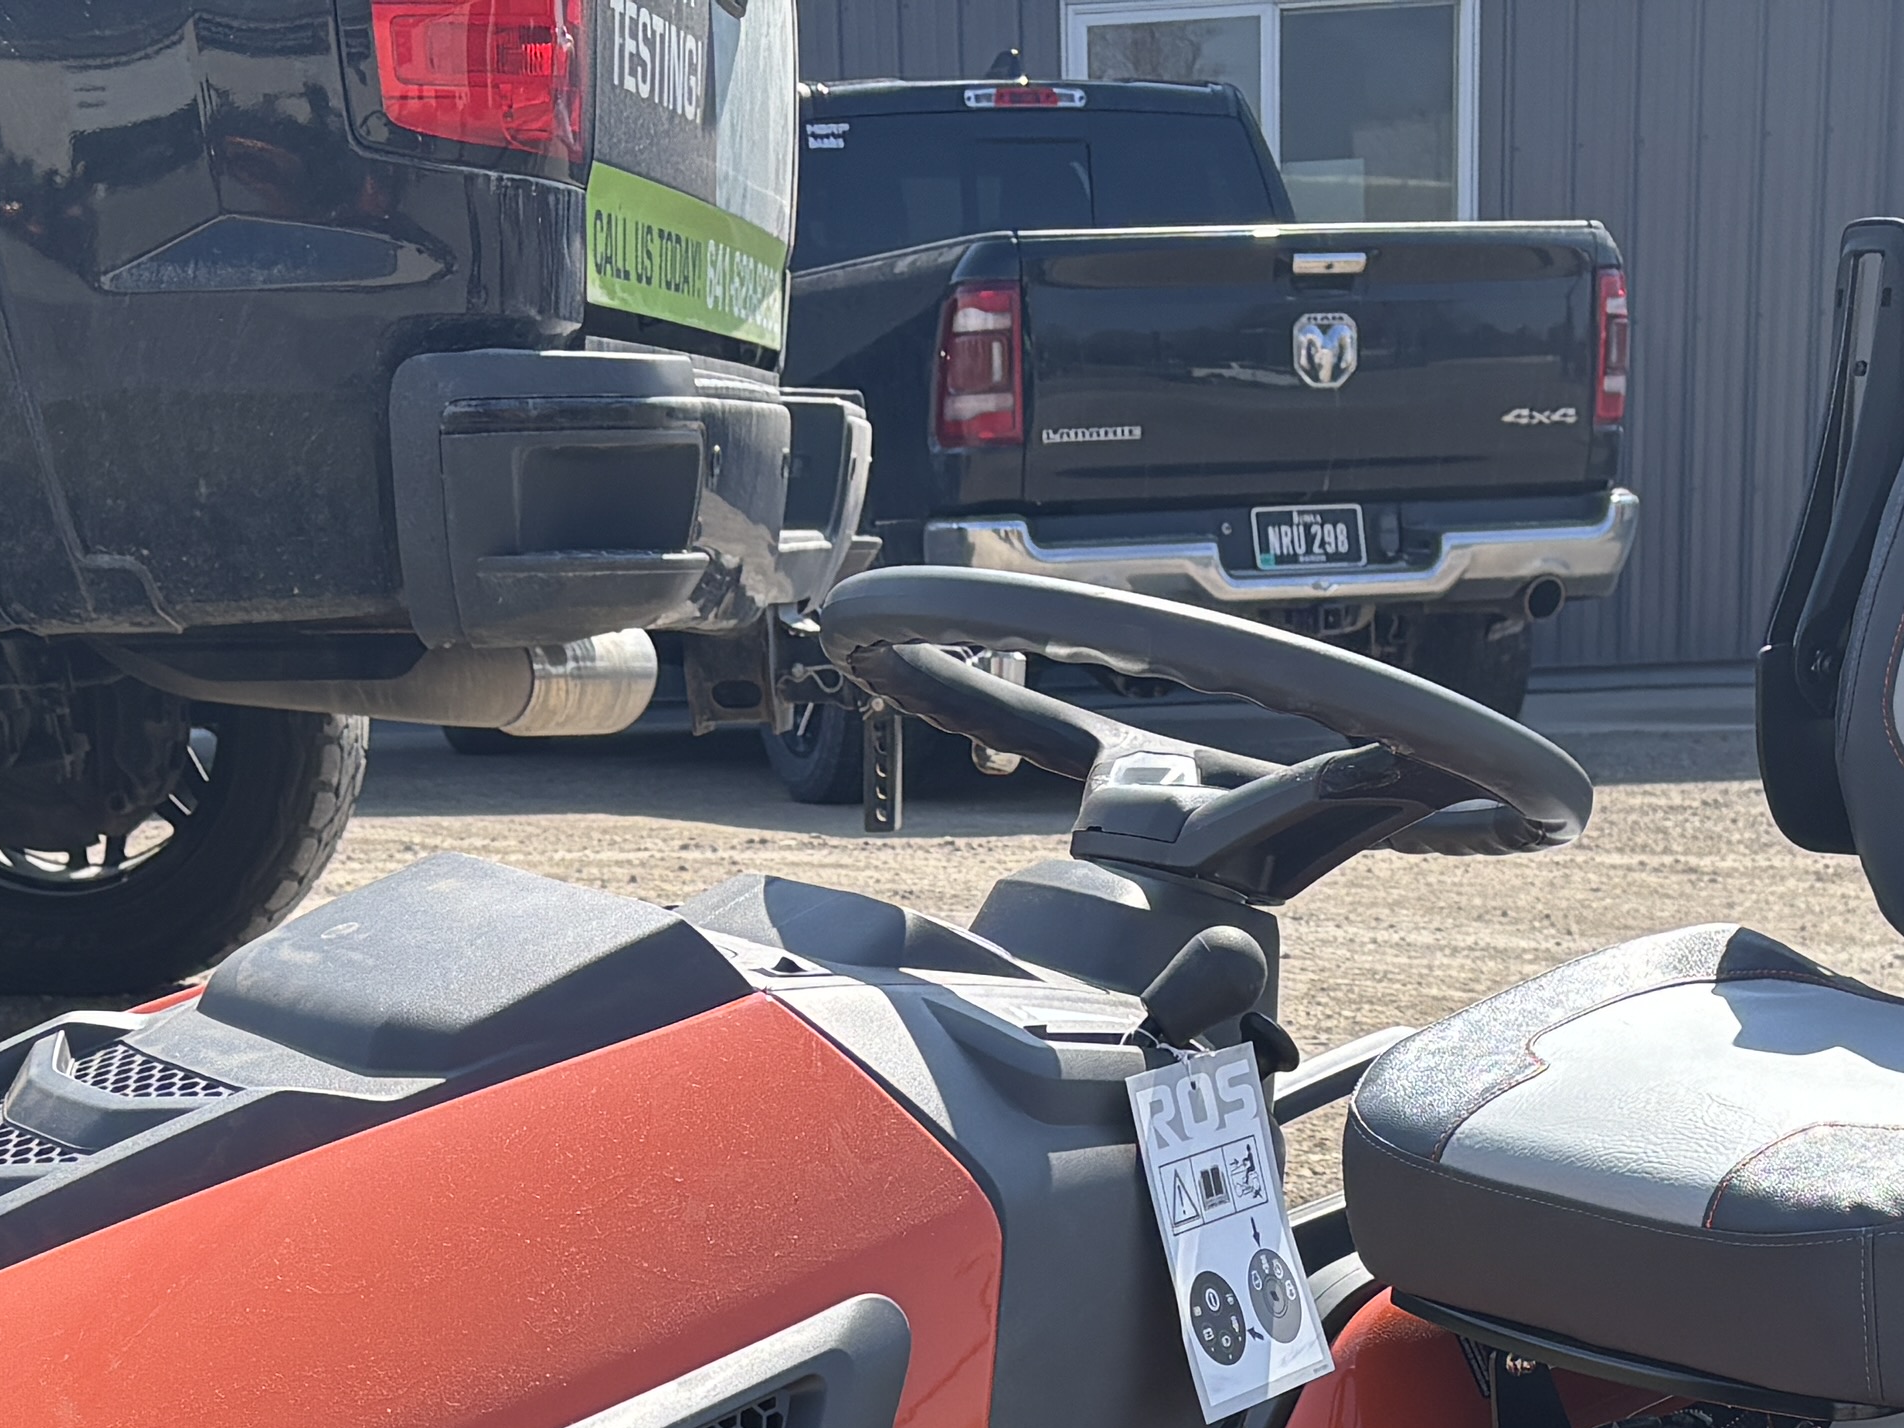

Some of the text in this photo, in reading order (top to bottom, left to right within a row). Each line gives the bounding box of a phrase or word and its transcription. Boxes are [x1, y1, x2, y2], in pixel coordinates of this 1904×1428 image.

[610, 0, 702, 124] TESTING!
[593, 209, 631, 282] CALL
[635, 220, 654, 287] US
[658, 227, 702, 299] TODAY!
[1042, 426, 1142, 444] LARAMIE
[1501, 407, 1578, 425] 4x4
[1267, 522, 1349, 556] NRU 298
[1136, 1059, 1258, 1150] ROS
